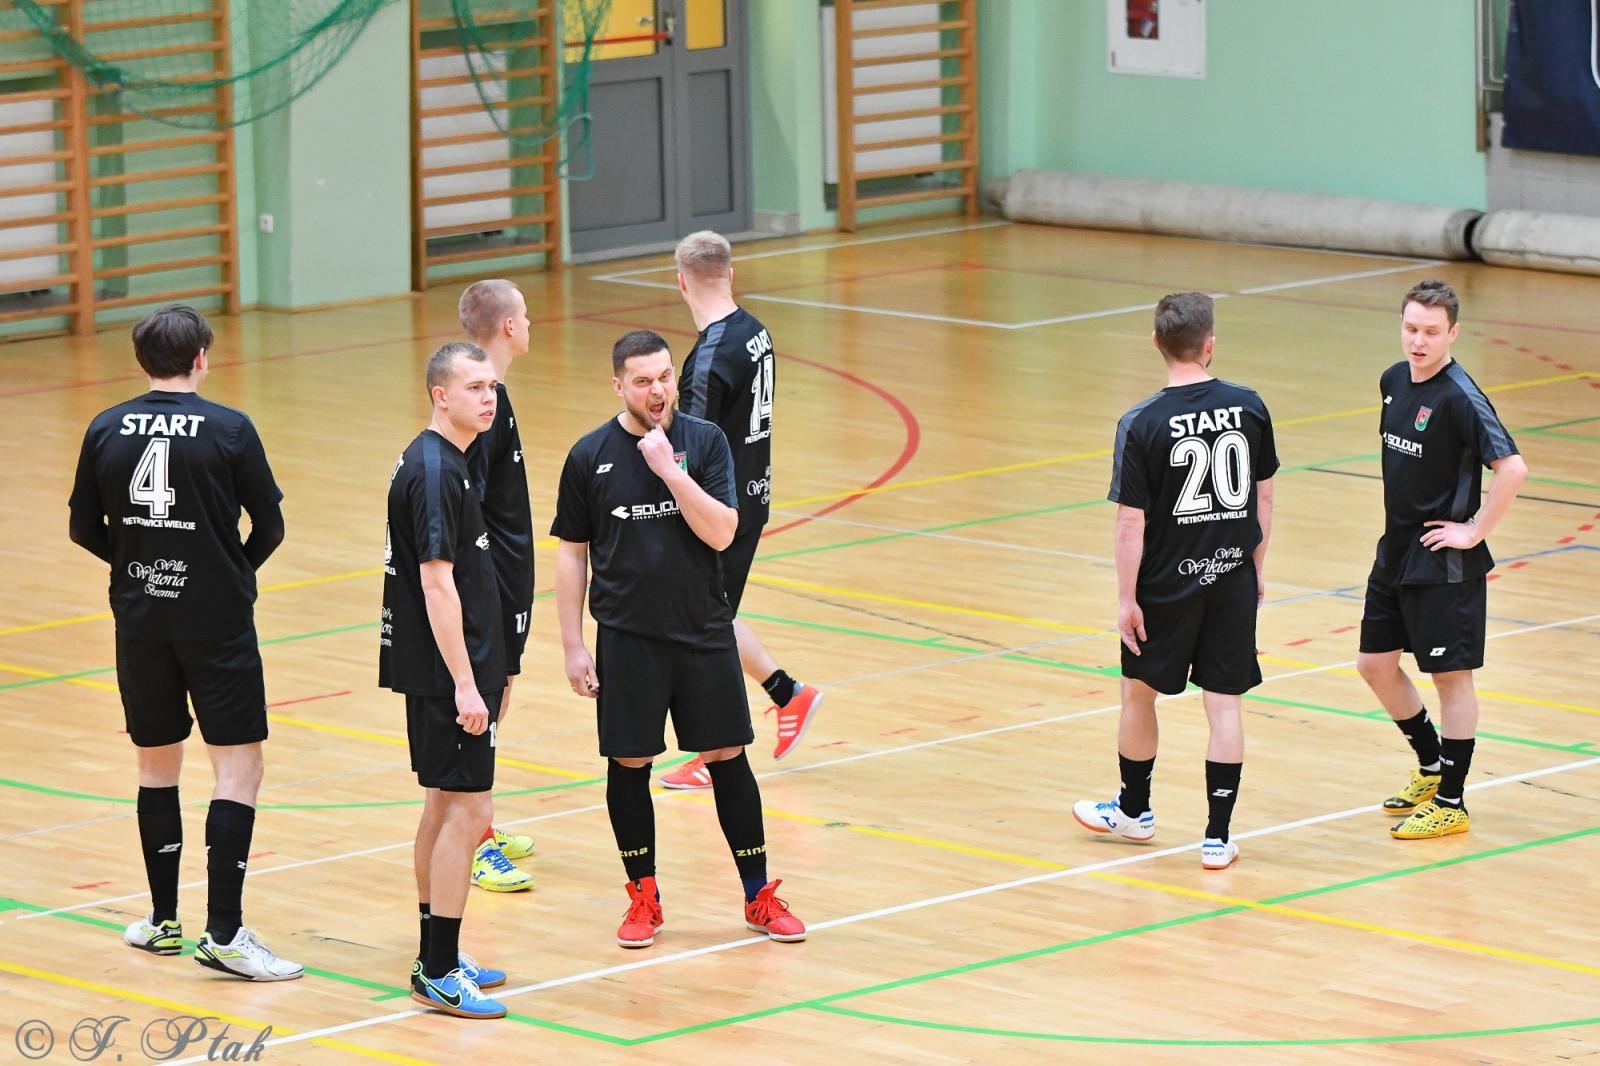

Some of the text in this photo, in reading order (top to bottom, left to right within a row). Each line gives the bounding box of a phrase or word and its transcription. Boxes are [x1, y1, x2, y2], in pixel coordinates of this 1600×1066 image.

[750, 354, 773, 436] 14
[120, 413, 205, 437] START
[1169, 406, 1243, 438] START
[129, 437, 175, 518] 4
[1170, 430, 1250, 515] 20
[631, 500, 680, 516] SOLIDU
[1177, 510, 1248, 525] PIETROWICE WIELKIE
[122, 516, 196, 530] PIETROWICE WIELKIE
[127, 561, 188, 587] Wiktoria
[154, 558, 188, 572] Willa
